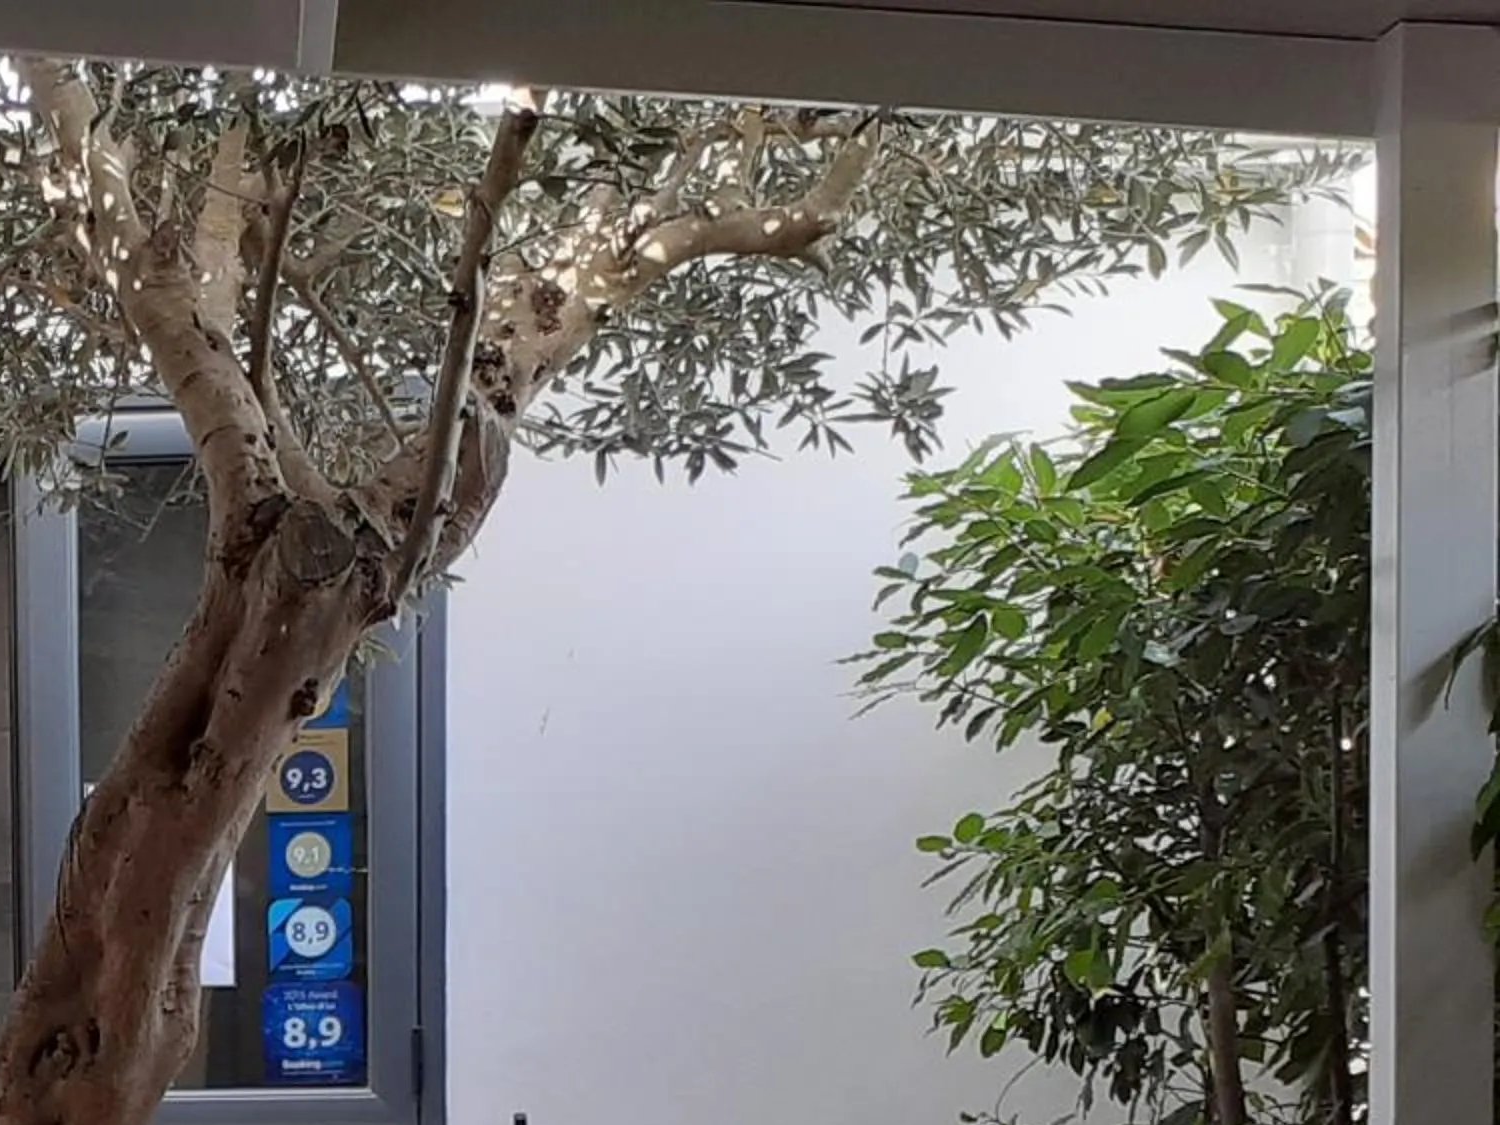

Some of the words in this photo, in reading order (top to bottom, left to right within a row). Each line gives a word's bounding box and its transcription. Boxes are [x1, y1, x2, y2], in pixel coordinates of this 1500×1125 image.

[286, 767, 327, 793] 9,3
[292, 921, 329, 945] 8,9
[283, 1016, 341, 1050] 8,9
